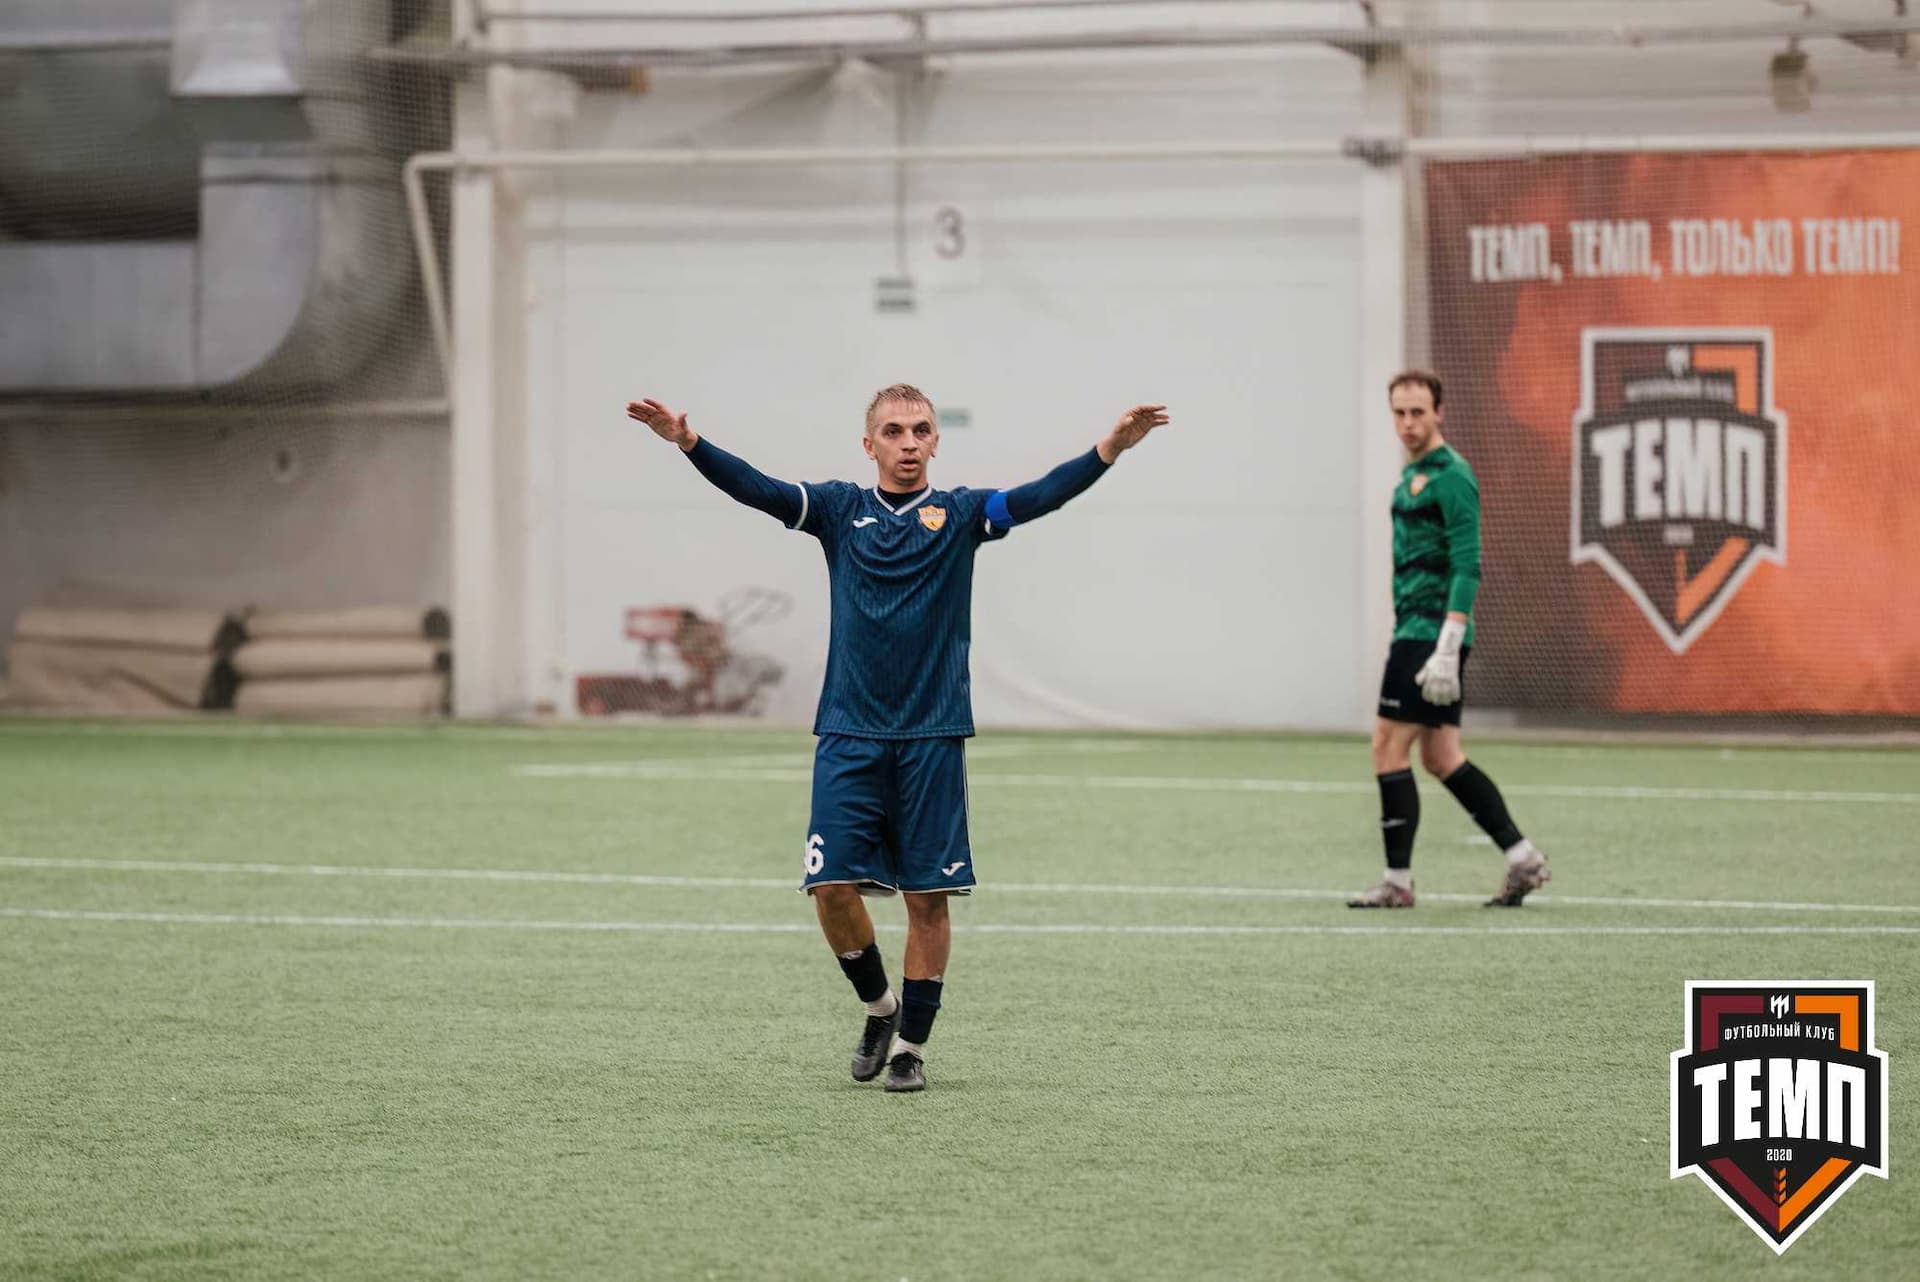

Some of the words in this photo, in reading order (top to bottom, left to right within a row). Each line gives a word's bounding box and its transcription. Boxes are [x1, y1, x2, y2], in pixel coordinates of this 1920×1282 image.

[934, 205, 966, 261] 3
[1468, 223, 1563, 284] ТЕМП,
[1568, 219, 1662, 282] ТЕМП,
[1669, 218, 1794, 276] ТОЛЬКО
[1801, 217, 1900, 276] ТЕМП!
[1591, 417, 1767, 531] ТЕМП
[804, 833, 826, 876] 6
